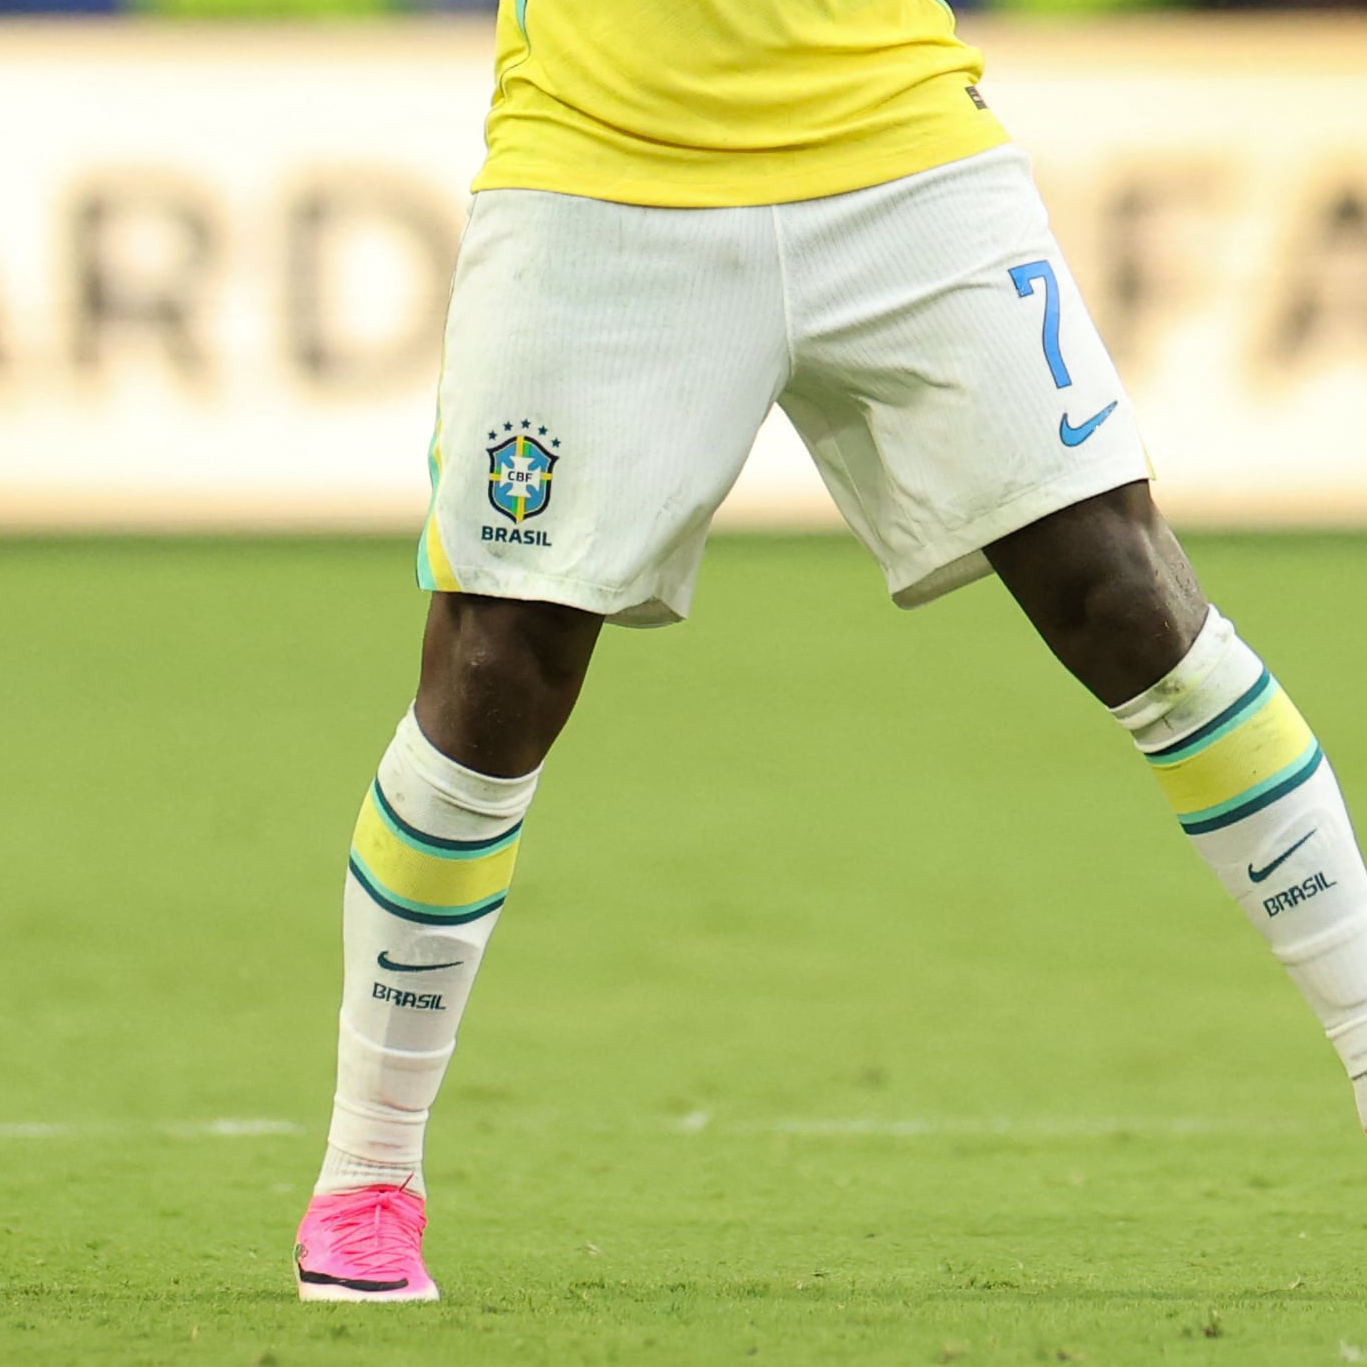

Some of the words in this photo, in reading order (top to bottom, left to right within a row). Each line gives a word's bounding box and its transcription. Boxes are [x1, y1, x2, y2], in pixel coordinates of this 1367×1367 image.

[1007, 259, 1072, 389] 7
[507, 470, 533, 483] CBF
[481, 525, 552, 547] BRASIL
[1263, 871, 1337, 918] BRASIL
[372, 981, 447, 1010] BRASIL
